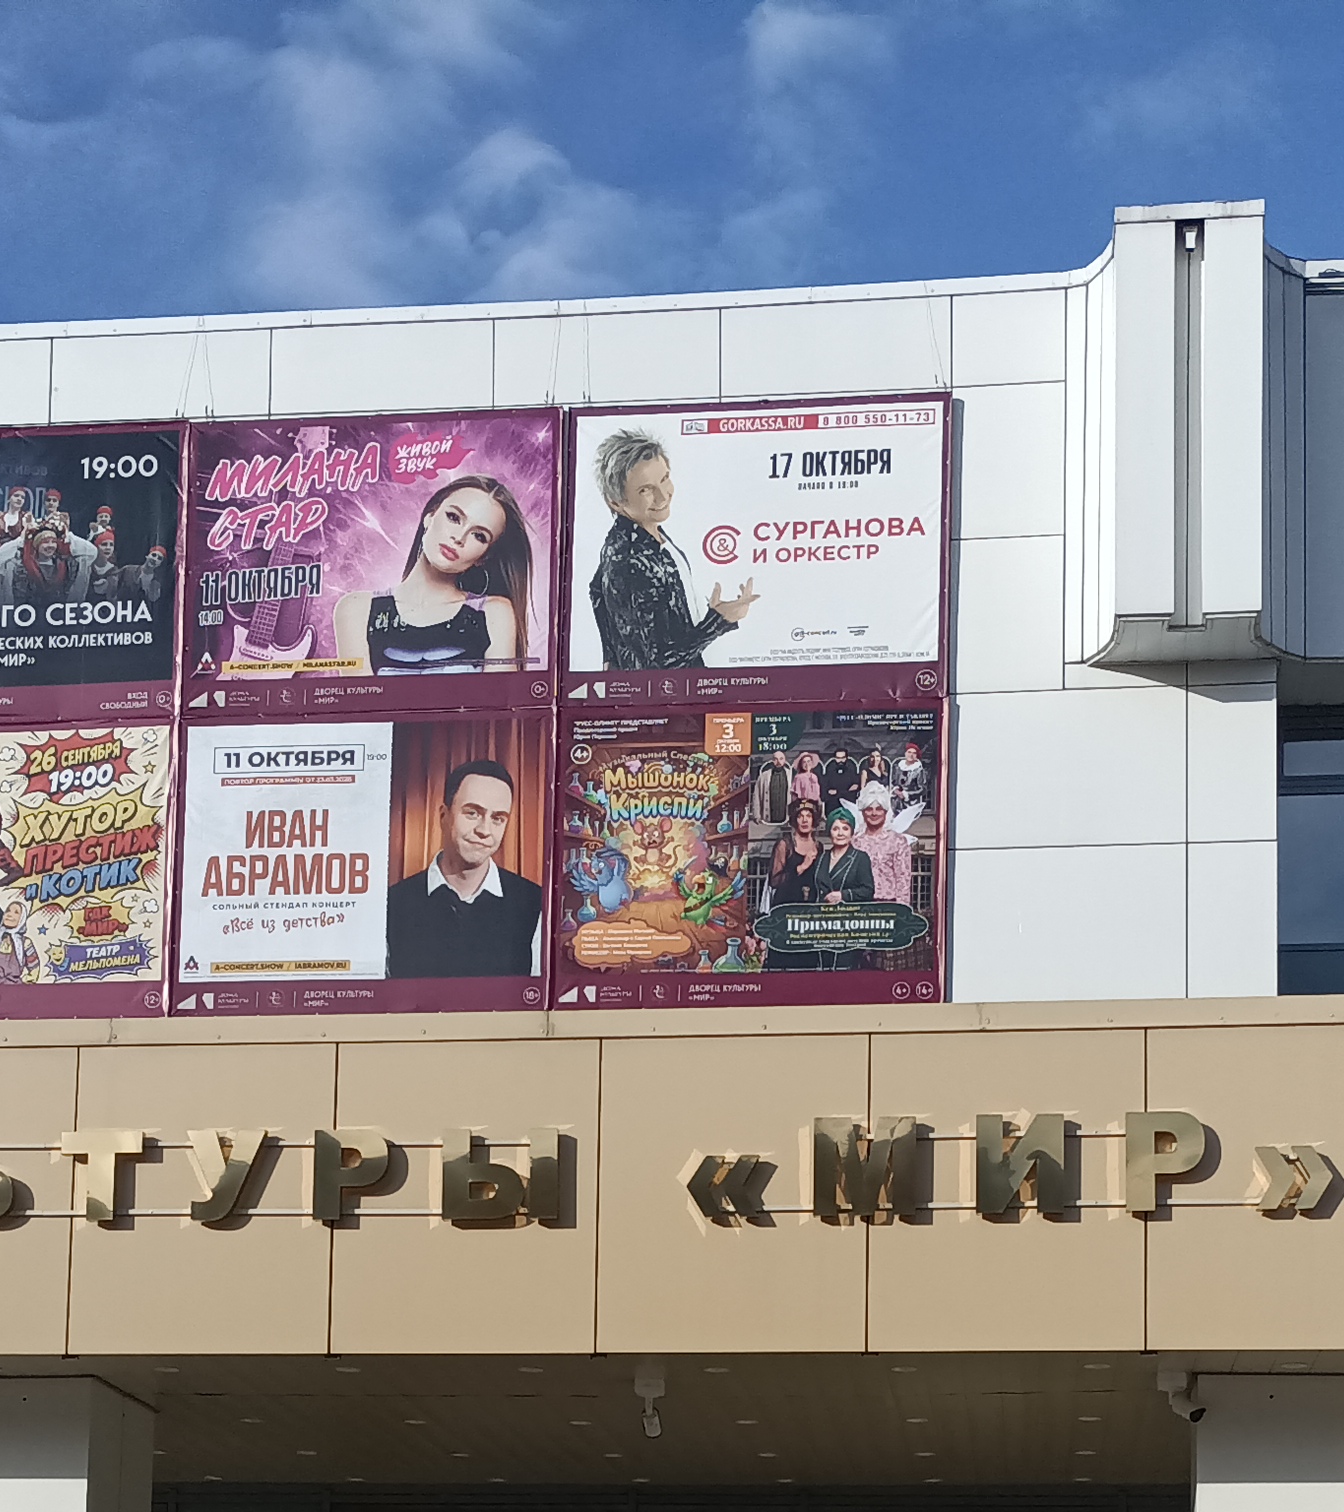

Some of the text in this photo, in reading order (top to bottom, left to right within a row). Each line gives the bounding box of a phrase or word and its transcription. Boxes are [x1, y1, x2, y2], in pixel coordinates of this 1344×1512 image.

[719, 416, 805, 432] GORKASSA.RU
[822, 412, 931, 426] 8 800 550-11-73
[394, 437, 452, 460] ЖИВОЙ
[80, 455, 158, 480] 19:00
[205, 442, 380, 502] МИЛАНА
[394, 456, 435, 474] ЗВУК
[768, 448, 892, 479] 17 ОКТЯБРЯ
[207, 497, 328, 552] СТАР
[753, 516, 926, 542] СУРГАНОВА
[752, 544, 880, 564] И ОРКЕСТР
[200, 563, 323, 605] 11 ОКТЯБРЯ
[46, 600, 152, 626] СЕЗОНА
[48, 631, 153, 648] КОЛЛЕКТИВОВ
[918, 674, 936, 686] 12+
[721, 723, 734, 739] 3
[768, 723, 778, 736] 3
[28, 739, 123, 775] 26 СЕНТЯБРЯ
[223, 752, 241, 769] 11
[247, 749, 356, 768] ОКТЯБРЯ
[714, 744, 742, 753] 12:00
[48, 762, 114, 794] 19:00
[19, 799, 139, 848] ХУТОР
[244, 808, 329, 850] ИВАН
[22, 824, 159, 877] ПРЕСТИЖ
[39, 857, 143, 902] КОТИК
[201, 852, 370, 898] АБРАМОВ
[212, 901, 357, 911] СОЛЬНЫЙ СТЕНДАП КОНЦЕРТ
[222, 911, 345, 935] «Всё из детства»
[786, 919, 895, 934] Примадонны
[69, 953, 141, 973] МЕЛЬПОМЕНА
[85, 944, 121, 959] ТЕАТР
[686, 1111, 1333, 1216] «МИР»
